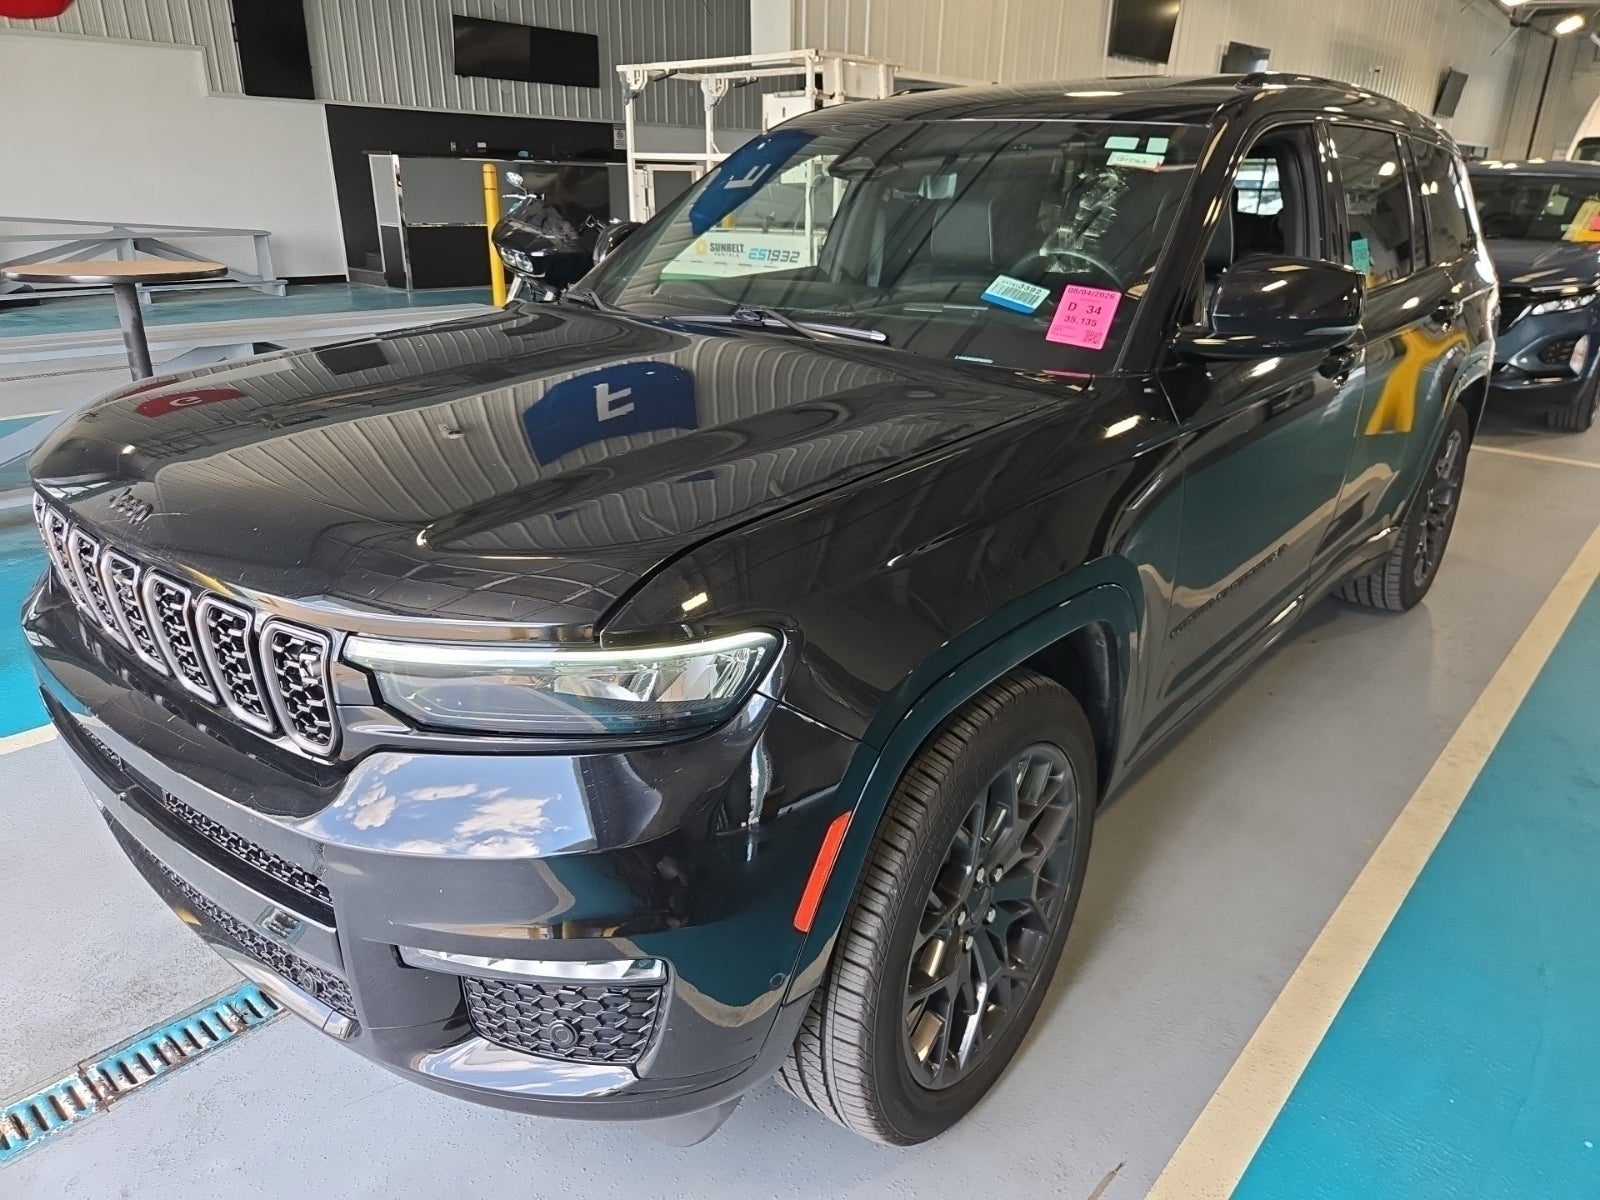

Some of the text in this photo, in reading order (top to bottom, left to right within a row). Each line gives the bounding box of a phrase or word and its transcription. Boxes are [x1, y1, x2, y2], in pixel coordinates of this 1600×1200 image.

[709, 242, 745, 254] SUNBELT
[748, 247, 801, 264] ES1932
[1067, 286, 1116, 300] 08/04/2026
[1067, 302, 1102, 315] D 34
